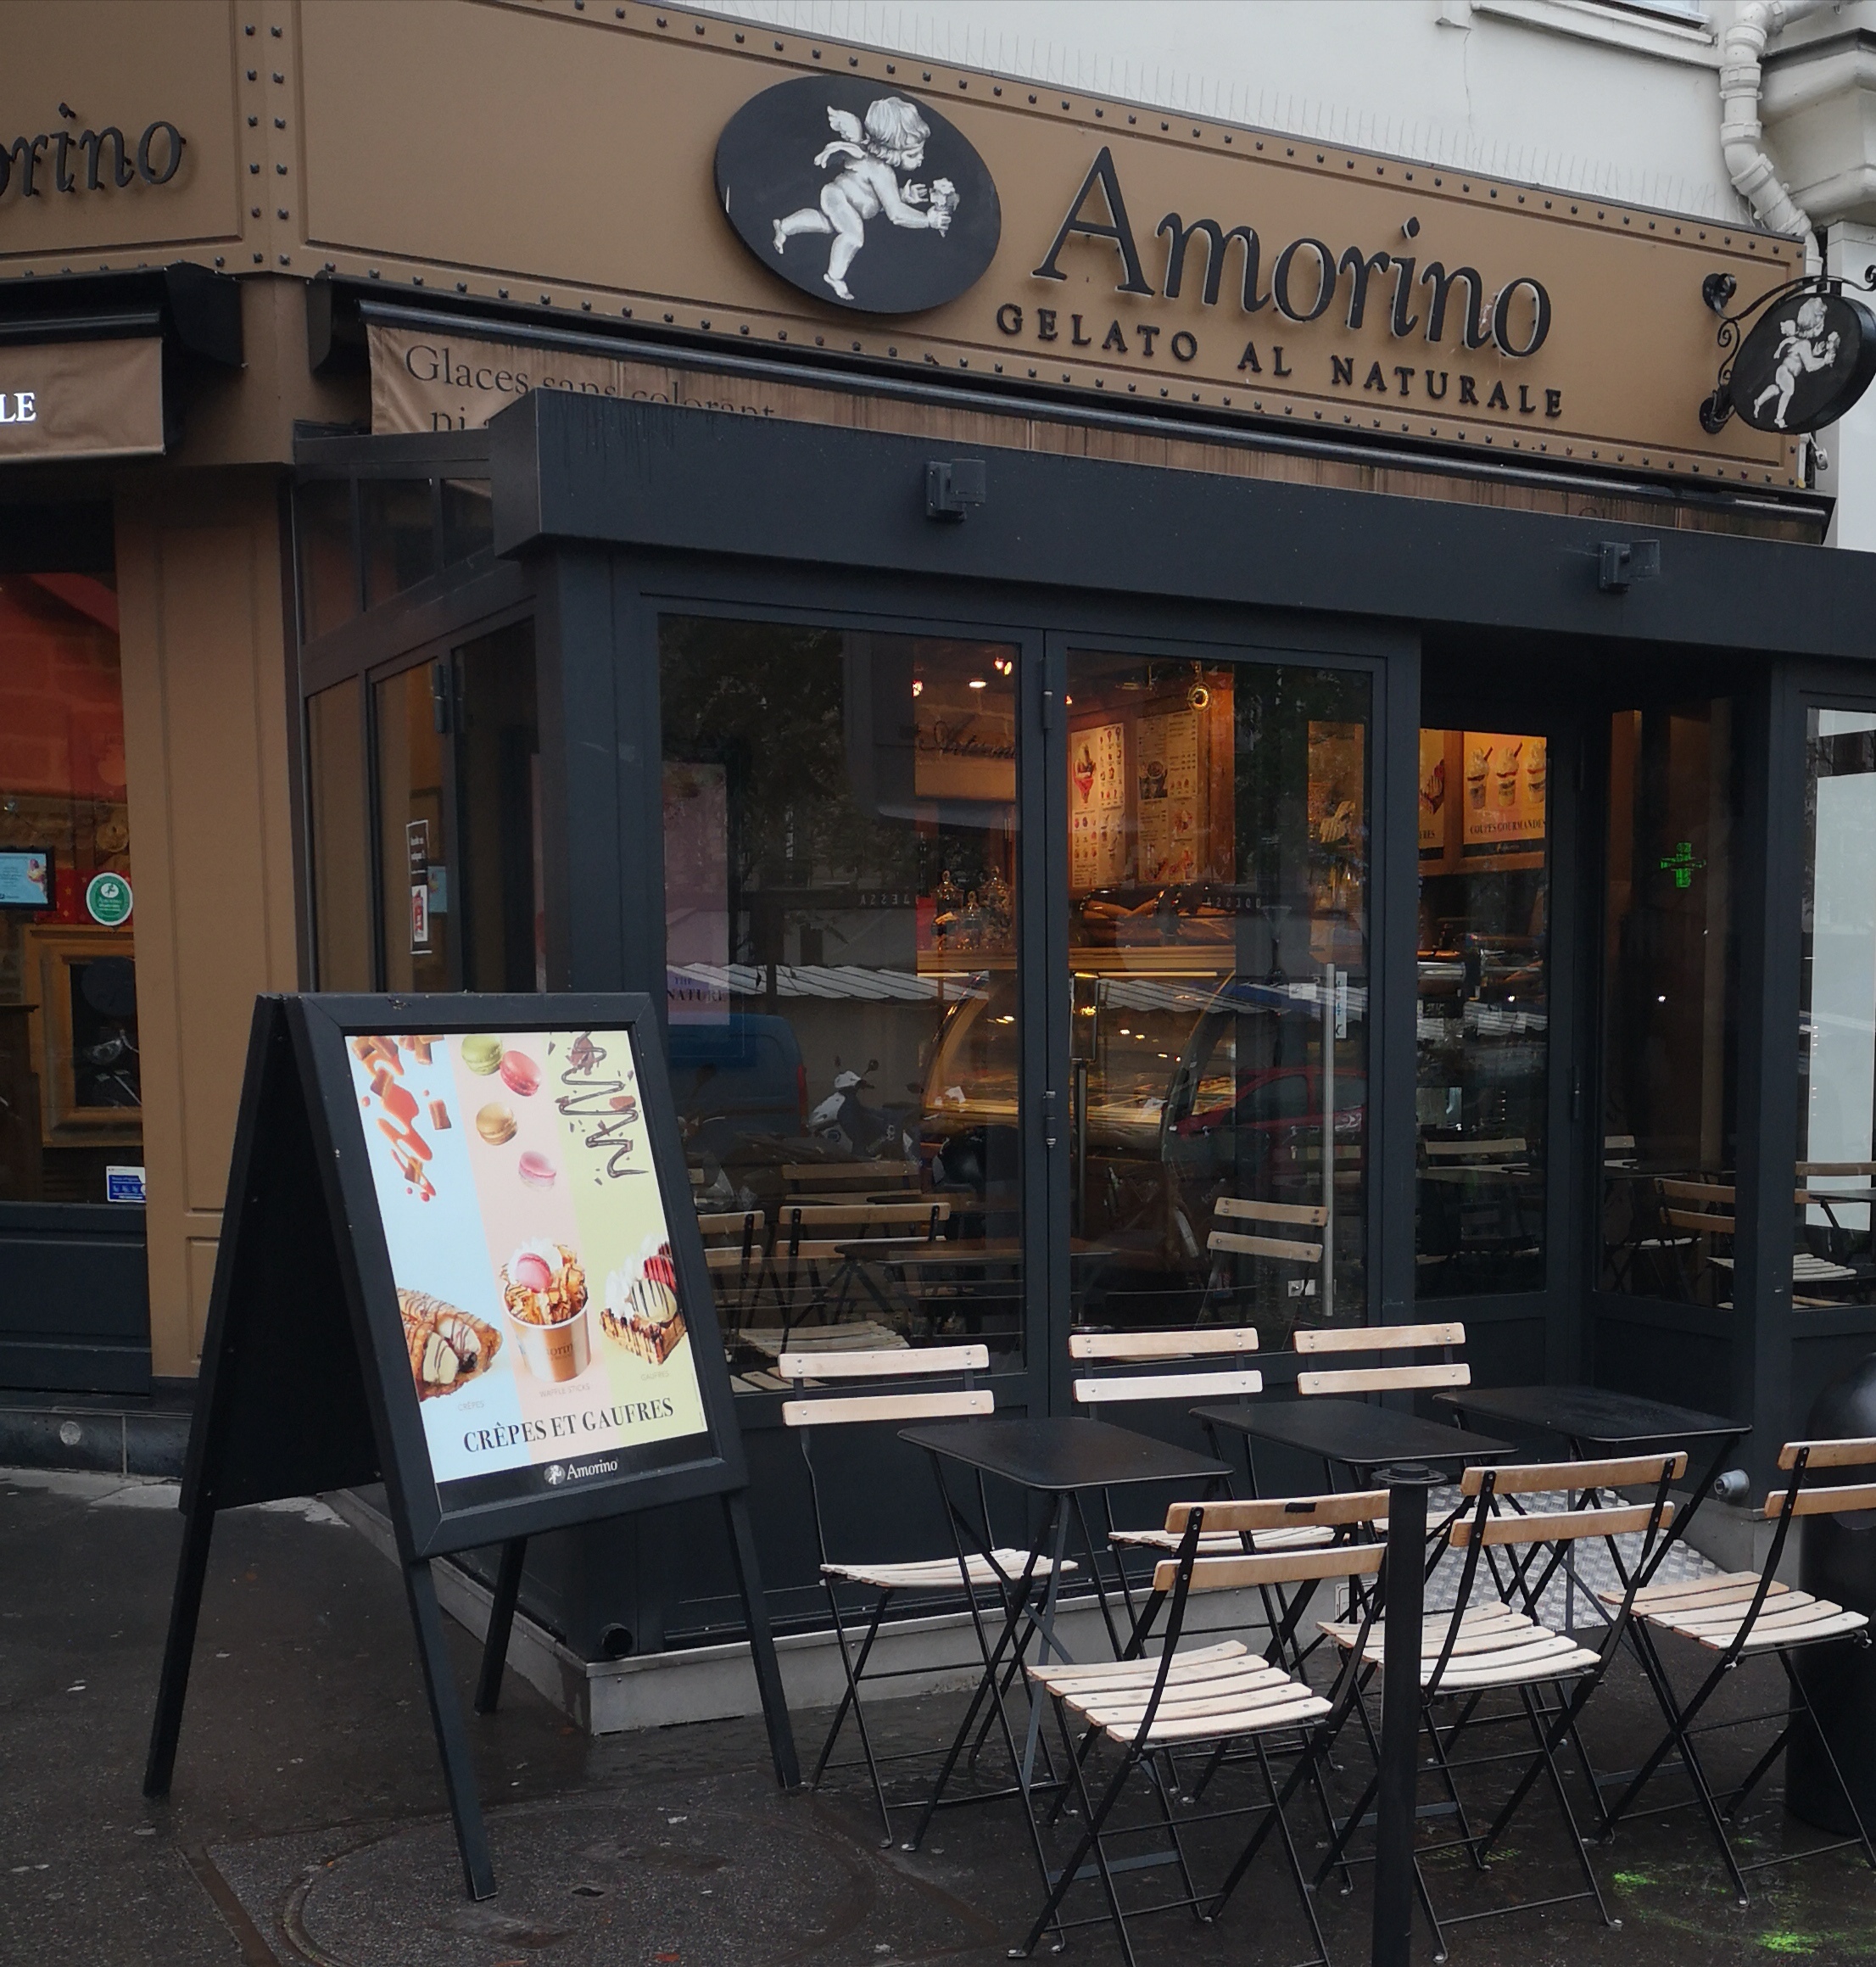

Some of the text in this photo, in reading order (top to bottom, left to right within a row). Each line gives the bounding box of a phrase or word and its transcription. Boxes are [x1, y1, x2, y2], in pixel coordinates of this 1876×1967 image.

[1031, 146, 1552, 358] Amorino
[405, 344, 531, 394] Glaces
[997, 303, 1563, 418] GELATO AL NATURALE
[539, 1383, 590, 1398] WAFFLE STICKS
[640, 1370, 670, 1382] GAUFRES
[463, 1421, 547, 1453] CRÊPES
[550, 1414, 578, 1438] ET
[582, 1397, 674, 1431] GAUFRES
[566, 1457, 618, 1481] Amorino
